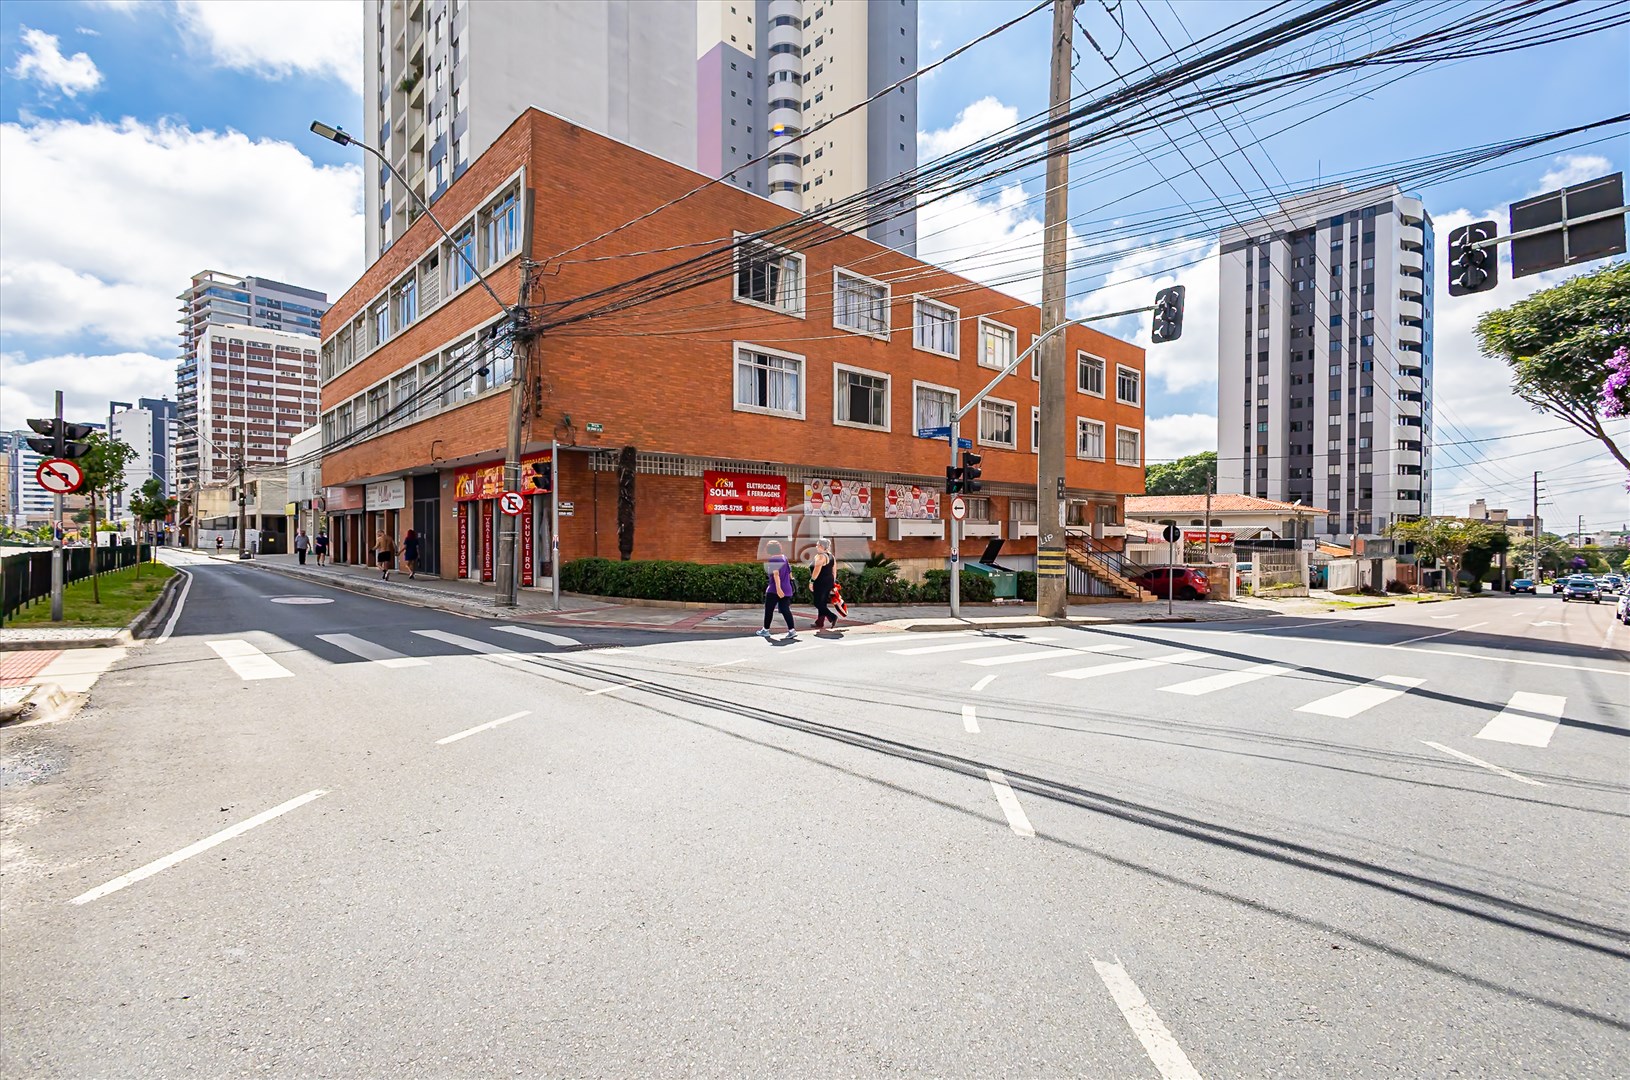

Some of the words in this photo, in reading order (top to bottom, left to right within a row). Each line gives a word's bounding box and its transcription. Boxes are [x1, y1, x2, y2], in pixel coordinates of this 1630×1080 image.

[746, 482, 781, 491] ELETRICIDADE
[709, 488, 739, 498] SOLMIL
[751, 490, 781, 498] FERRAGENS
